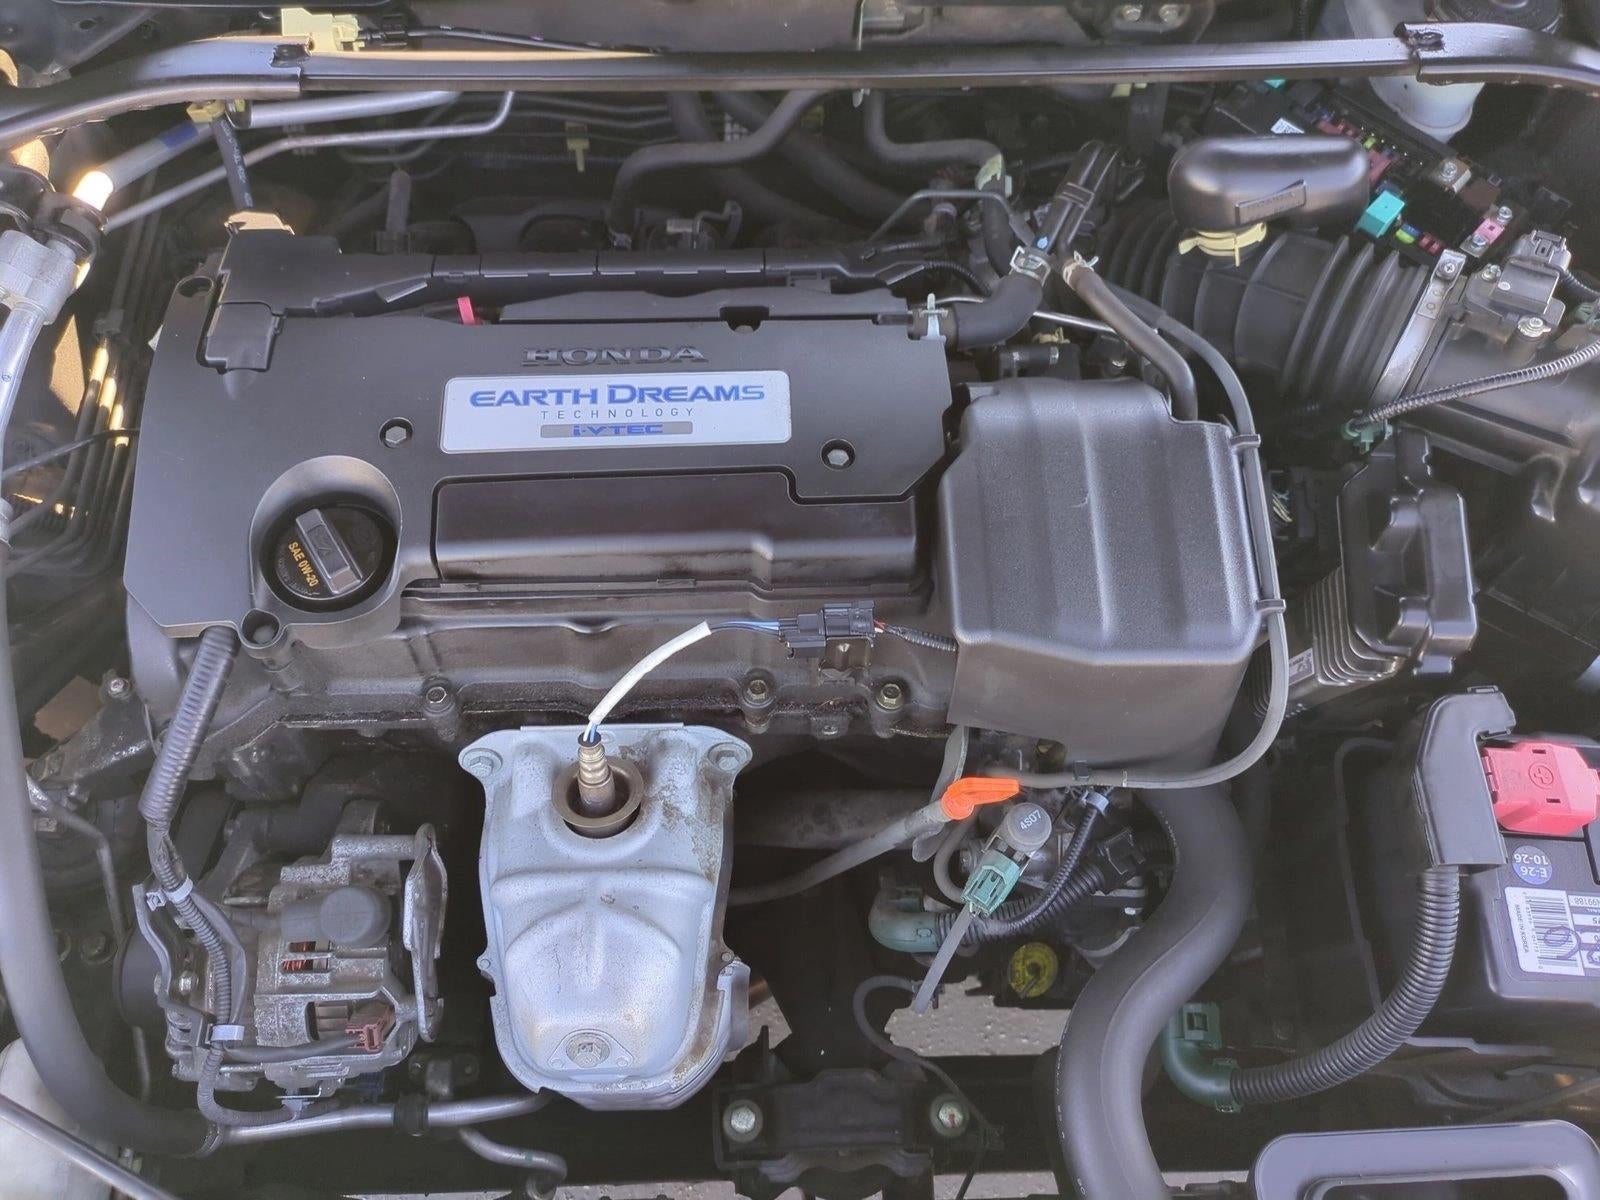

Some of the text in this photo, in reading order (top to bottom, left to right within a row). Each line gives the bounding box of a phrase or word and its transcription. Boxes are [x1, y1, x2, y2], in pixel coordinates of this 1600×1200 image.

[522, 345, 709, 367] HONDA
[470, 383, 766, 407] EARTH DREAMS
[541, 408, 694, 420] TECHNOLOGY
[288, 541, 305, 562] SAE
[298, 560, 319, 587] 0W-20
[1513, 853, 1549, 865] 10-26
[1520, 867, 1548, 878] E-26
